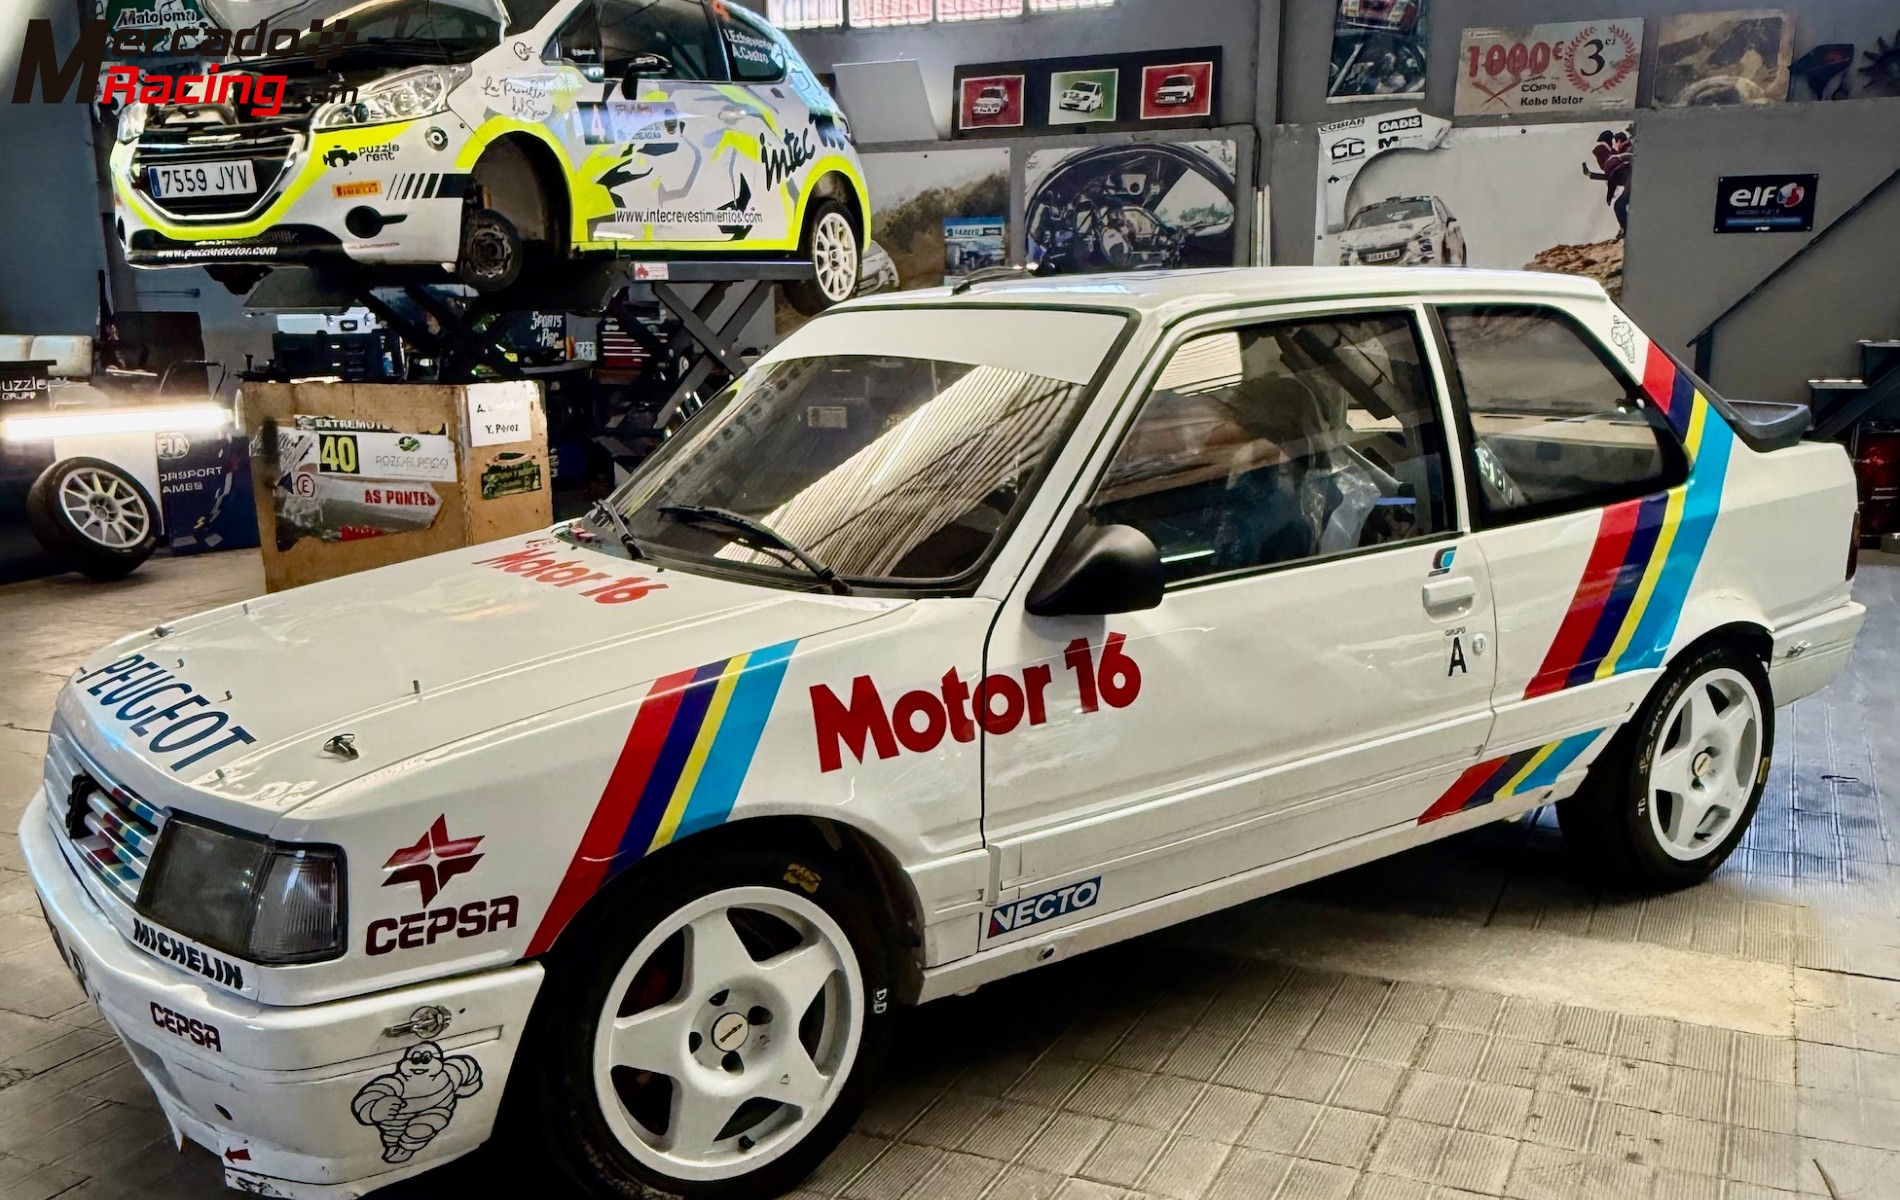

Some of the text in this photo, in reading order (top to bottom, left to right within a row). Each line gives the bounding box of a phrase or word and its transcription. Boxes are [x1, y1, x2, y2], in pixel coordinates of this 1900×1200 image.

[1468, 41, 1565, 78] 1000€
[358, 142, 400, 156] puzzle
[366, 150, 395, 162] rent
[161, 165, 247, 194] 7559 JYV
[1729, 186, 1777, 207] elf
[0, 376, 47, 392] uzzle
[321, 436, 356, 472] 40
[364, 489, 436, 507] AS PONTES
[472, 549, 669, 604] Motor 16
[1445, 626, 1466, 637] GRUPO
[1448, 637, 1468, 676] A
[76, 654, 257, 772] PEUGEOT
[809, 631, 1142, 773] Motor 16
[993, 881, 1098, 931] VECTO
[365, 895, 519, 956] CEPSA
[133, 917, 244, 990] MICHELIN
[150, 1001, 221, 1053] CEPSA
